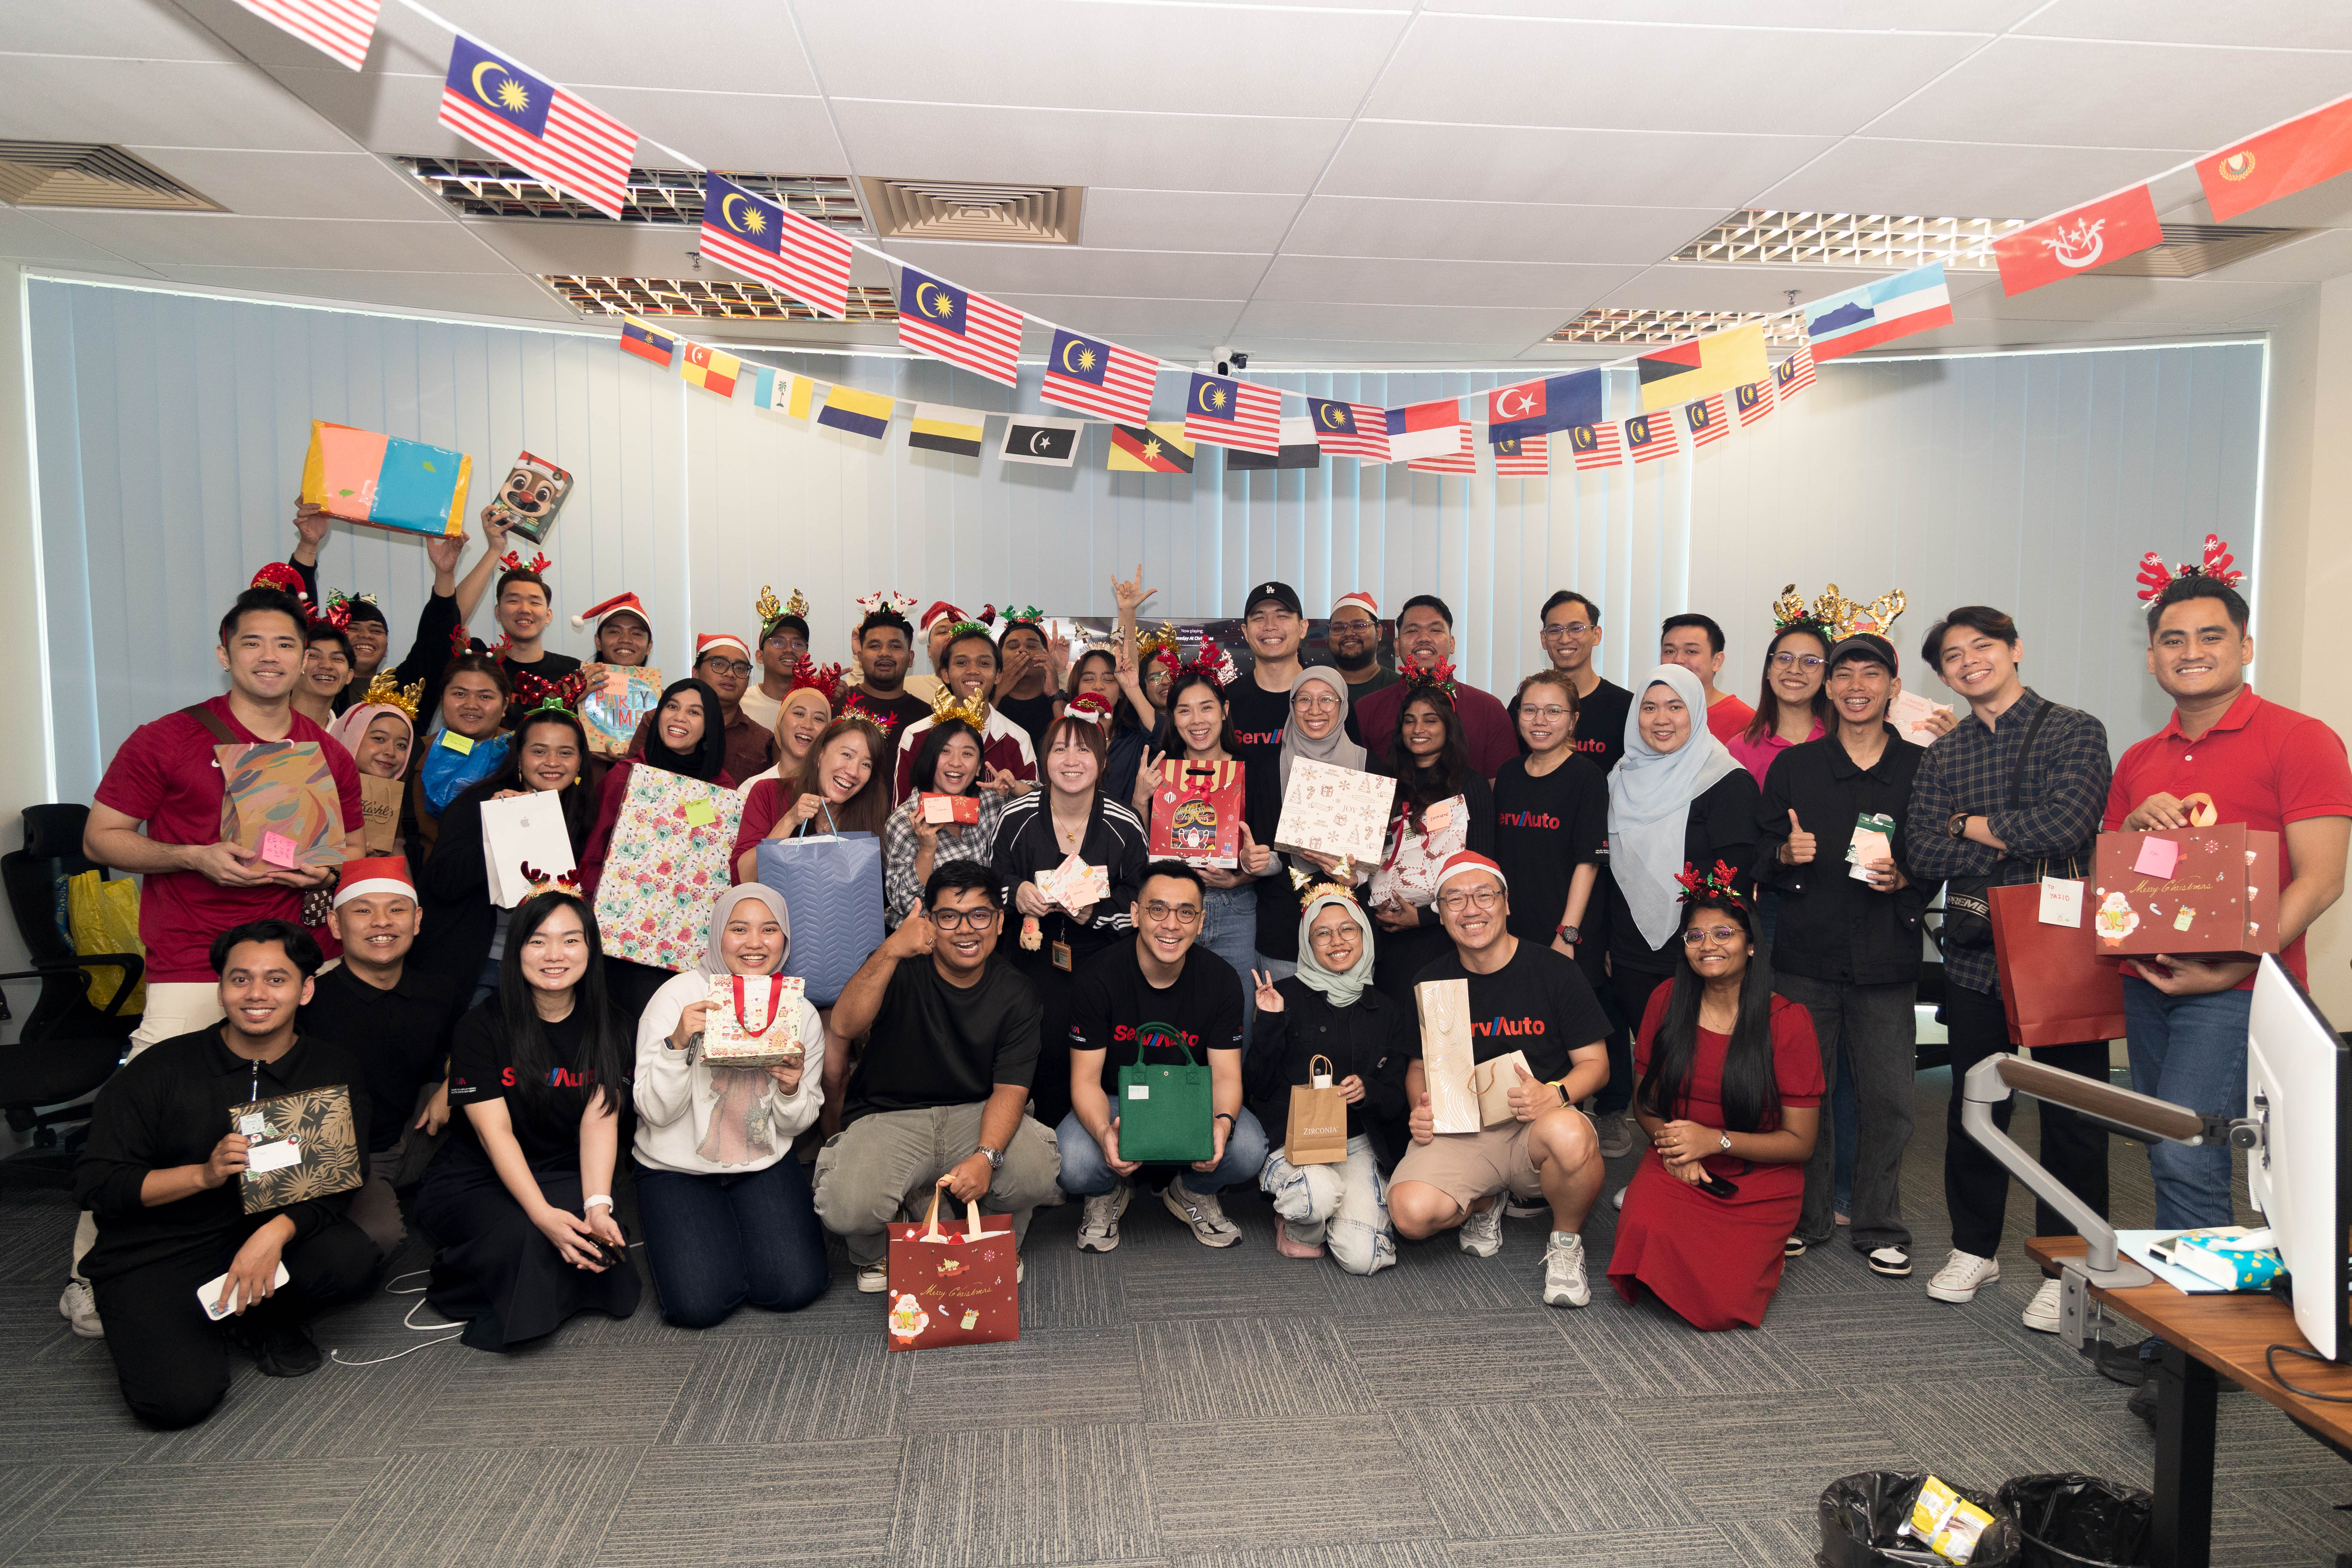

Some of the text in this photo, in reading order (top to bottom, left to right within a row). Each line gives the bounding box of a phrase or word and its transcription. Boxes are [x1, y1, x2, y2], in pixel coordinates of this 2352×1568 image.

[1266, 585, 1275, 594] LA
[595, 689, 651, 709] PARTY
[601, 707, 643, 727] TIME
[1342, 805, 1358, 814] JOY
[1499, 811, 1560, 829] ervAuto
[2129, 875, 2214, 897] Merry Christmas
[1948, 895, 1989, 914] PREME
[1114, 1025, 1199, 1047] SevAto
[1471, 1017, 1545, 1037] rvAuto
[920, 1282, 993, 1300] Merry Christmas
